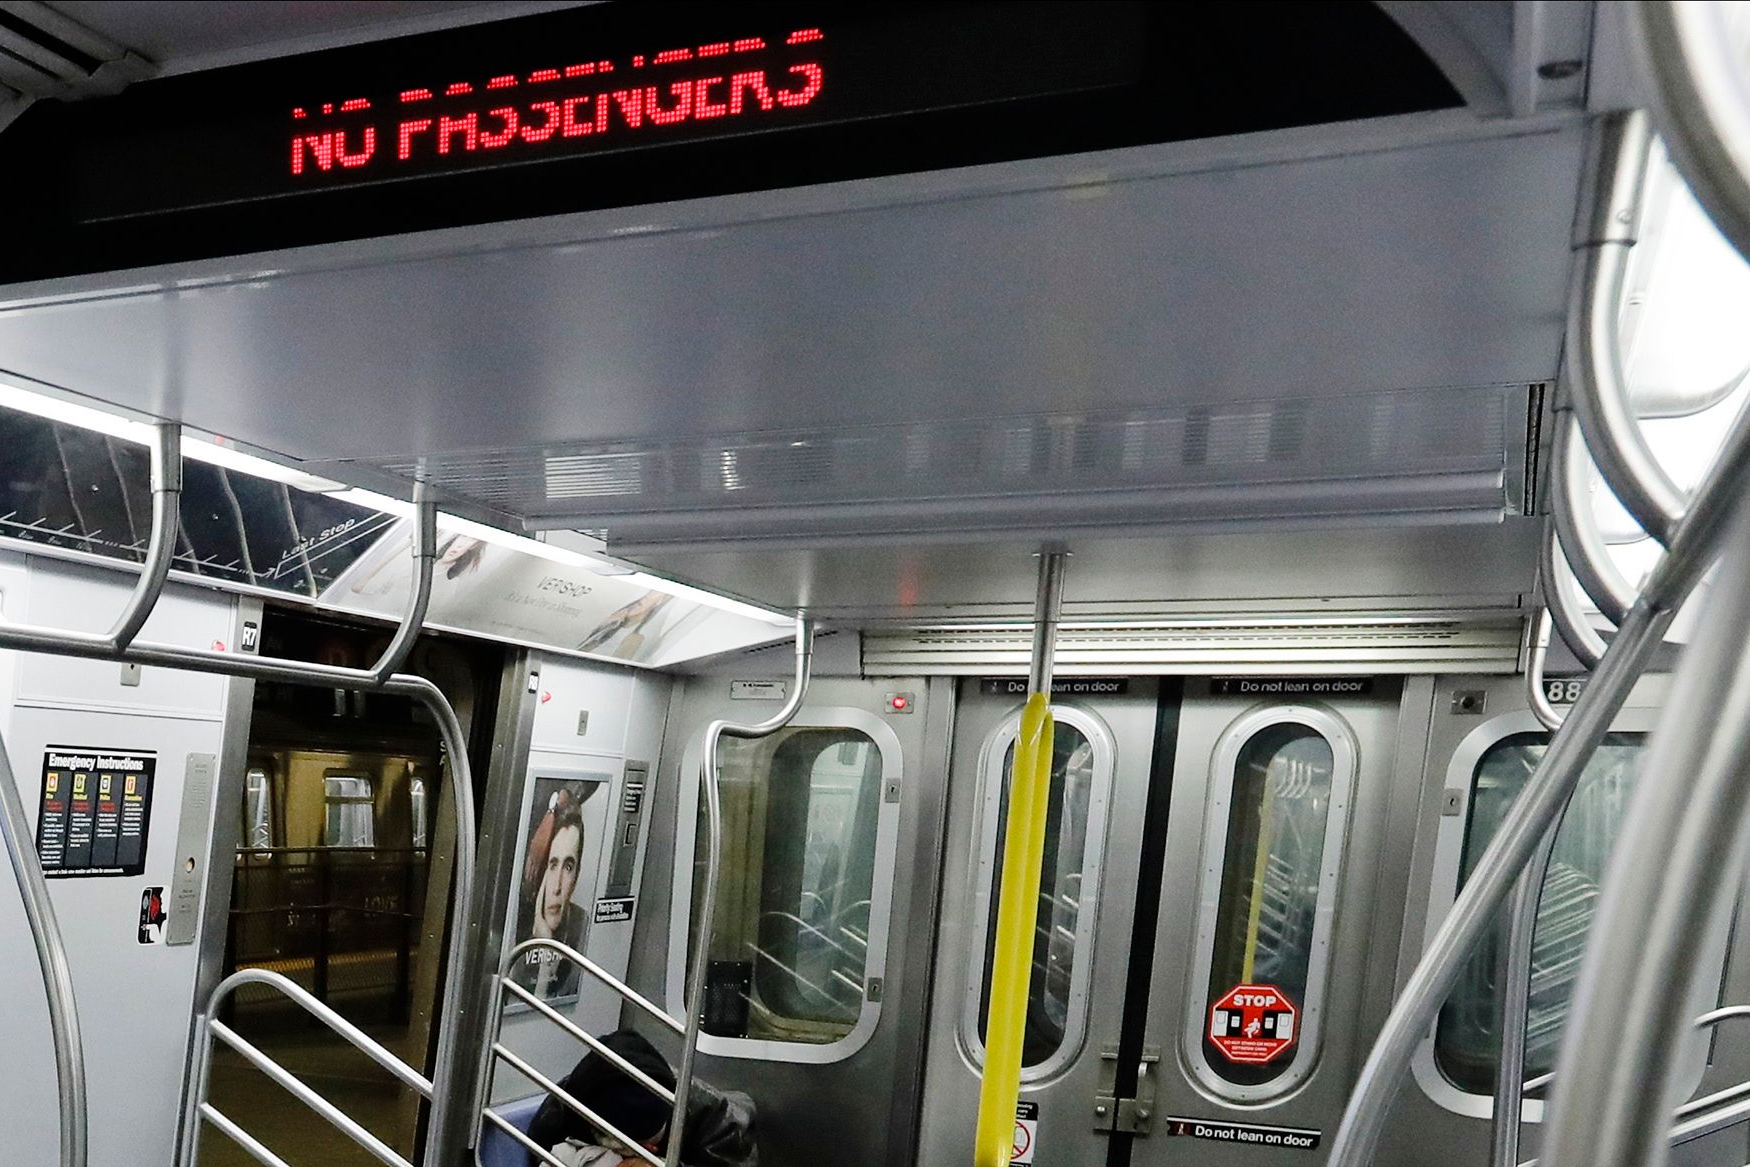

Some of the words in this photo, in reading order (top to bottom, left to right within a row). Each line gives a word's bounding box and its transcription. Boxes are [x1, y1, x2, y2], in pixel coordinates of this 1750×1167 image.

[292, 98, 375, 175] NO
[399, 28, 825, 160] PASSENGERS
[319, 518, 355, 541] Stop
[243, 626, 257, 646] R7
[1008, 682, 1025, 692] Do
[1050, 683, 1070, 692] ean
[1074, 683, 1089, 692] on
[1091, 681, 1119, 692] door
[1240, 681, 1259, 692] Do
[1261, 681, 1282, 692] not
[1284, 681, 1309, 692] lean
[1312, 682, 1329, 692] on
[1332, 681, 1363, 692] door
[48, 753, 96, 771] Emergency
[96, 756, 144, 771] Instructions
[1233, 994, 1277, 1007] STOP
[1195, 1125, 1213, 1137] Do
[1214, 1127, 1235, 1139] not
[1237, 1129, 1263, 1142] lean
[1265, 1133, 1281, 1144] on
[1283, 1135, 1314, 1147] door
